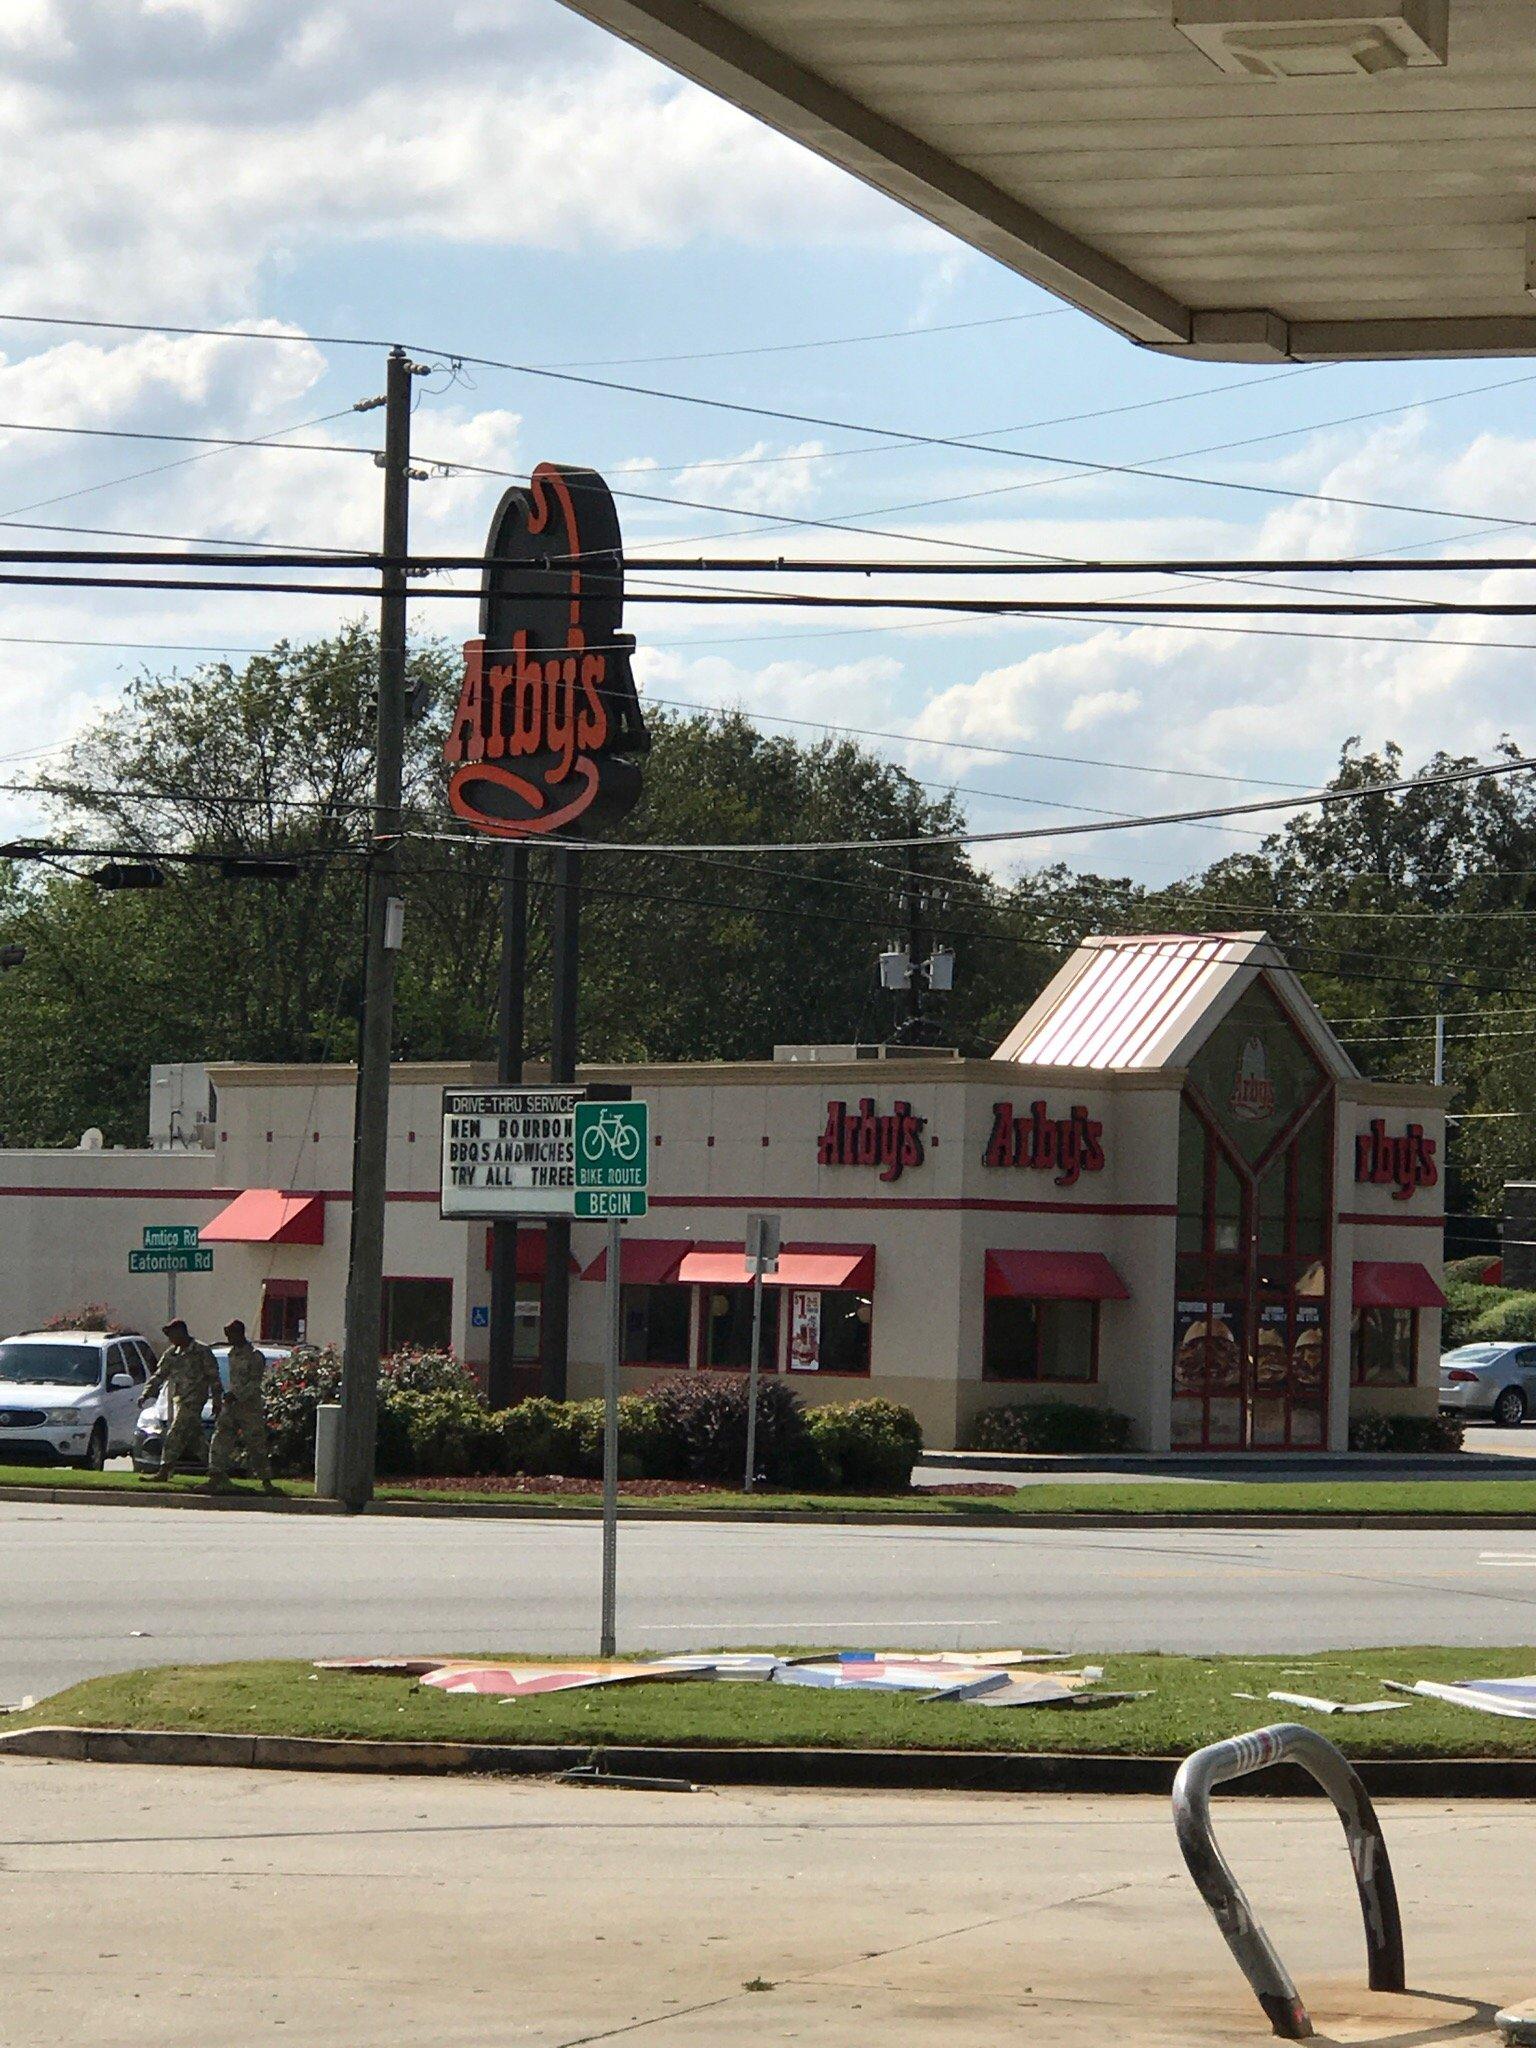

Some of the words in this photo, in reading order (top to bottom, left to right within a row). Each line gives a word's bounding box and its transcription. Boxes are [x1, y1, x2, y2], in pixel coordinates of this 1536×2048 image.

[444, 628, 607, 785] Arby's
[452, 1097, 523, 1112] DRIVE-THRU
[526, 1096, 574, 1112] SERVICE
[450, 1119, 480, 1138] NEW
[498, 1119, 572, 1138] BOURBON
[817, 1098, 927, 1182] Arby's
[982, 1100, 1105, 1186] Arby's
[450, 1166, 476, 1186] TRY
[485, 1166, 512, 1186] ALL
[530, 1166, 574, 1186] THREE
[580, 1168, 603, 1184] BIKE
[608, 1168, 642, 1184] ROUTE
[589, 1193, 631, 1214] BEGIN
[183, 1229, 197, 1246] Rd
[131, 1252, 188, 1270] Eatonton
[194, 1252, 211, 1269] Rd
